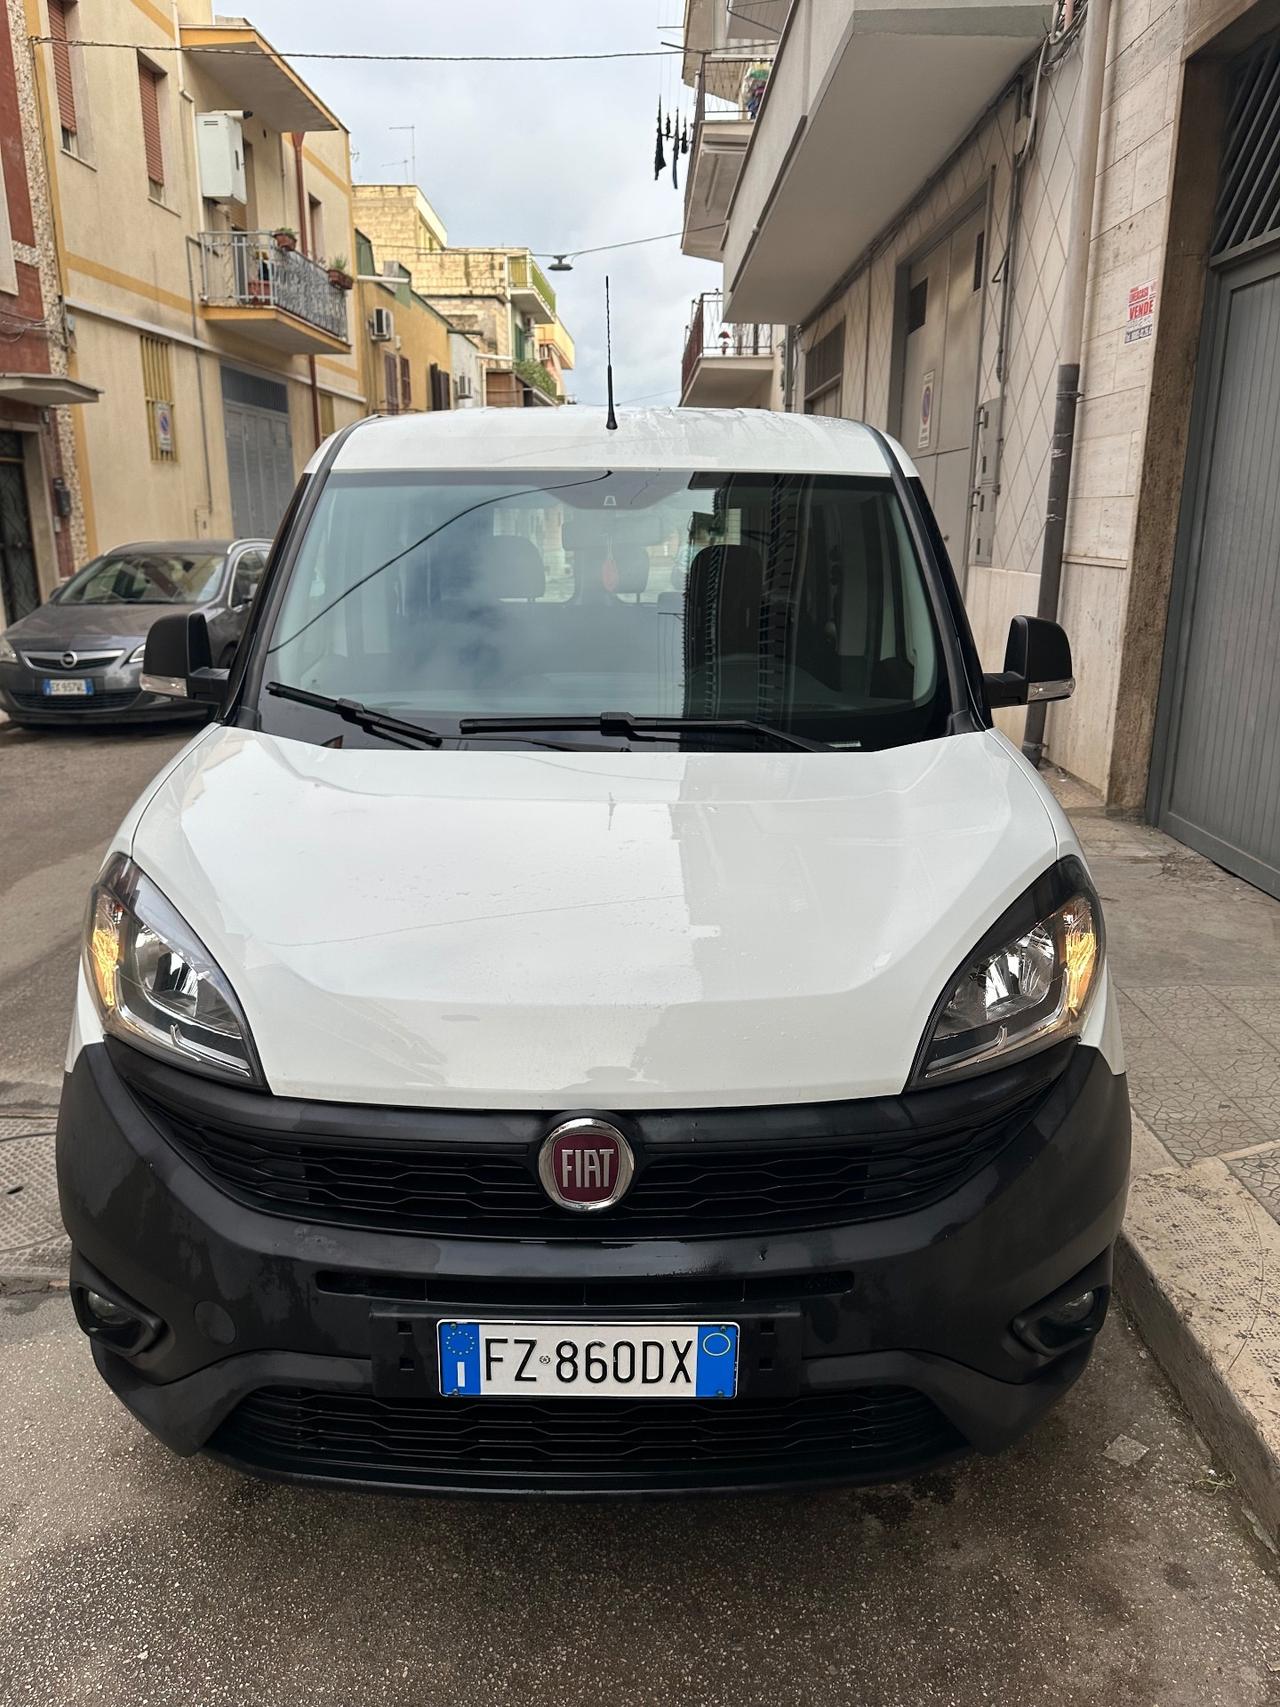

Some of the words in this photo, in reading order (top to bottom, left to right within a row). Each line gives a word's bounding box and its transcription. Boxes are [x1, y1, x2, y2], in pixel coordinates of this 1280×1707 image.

[1129, 300, 1153, 320] VENDE
[561, 1149, 614, 1188] FIAT
[484, 1337, 538, 1382] FZ
[555, 1340, 693, 1384] 860DX
